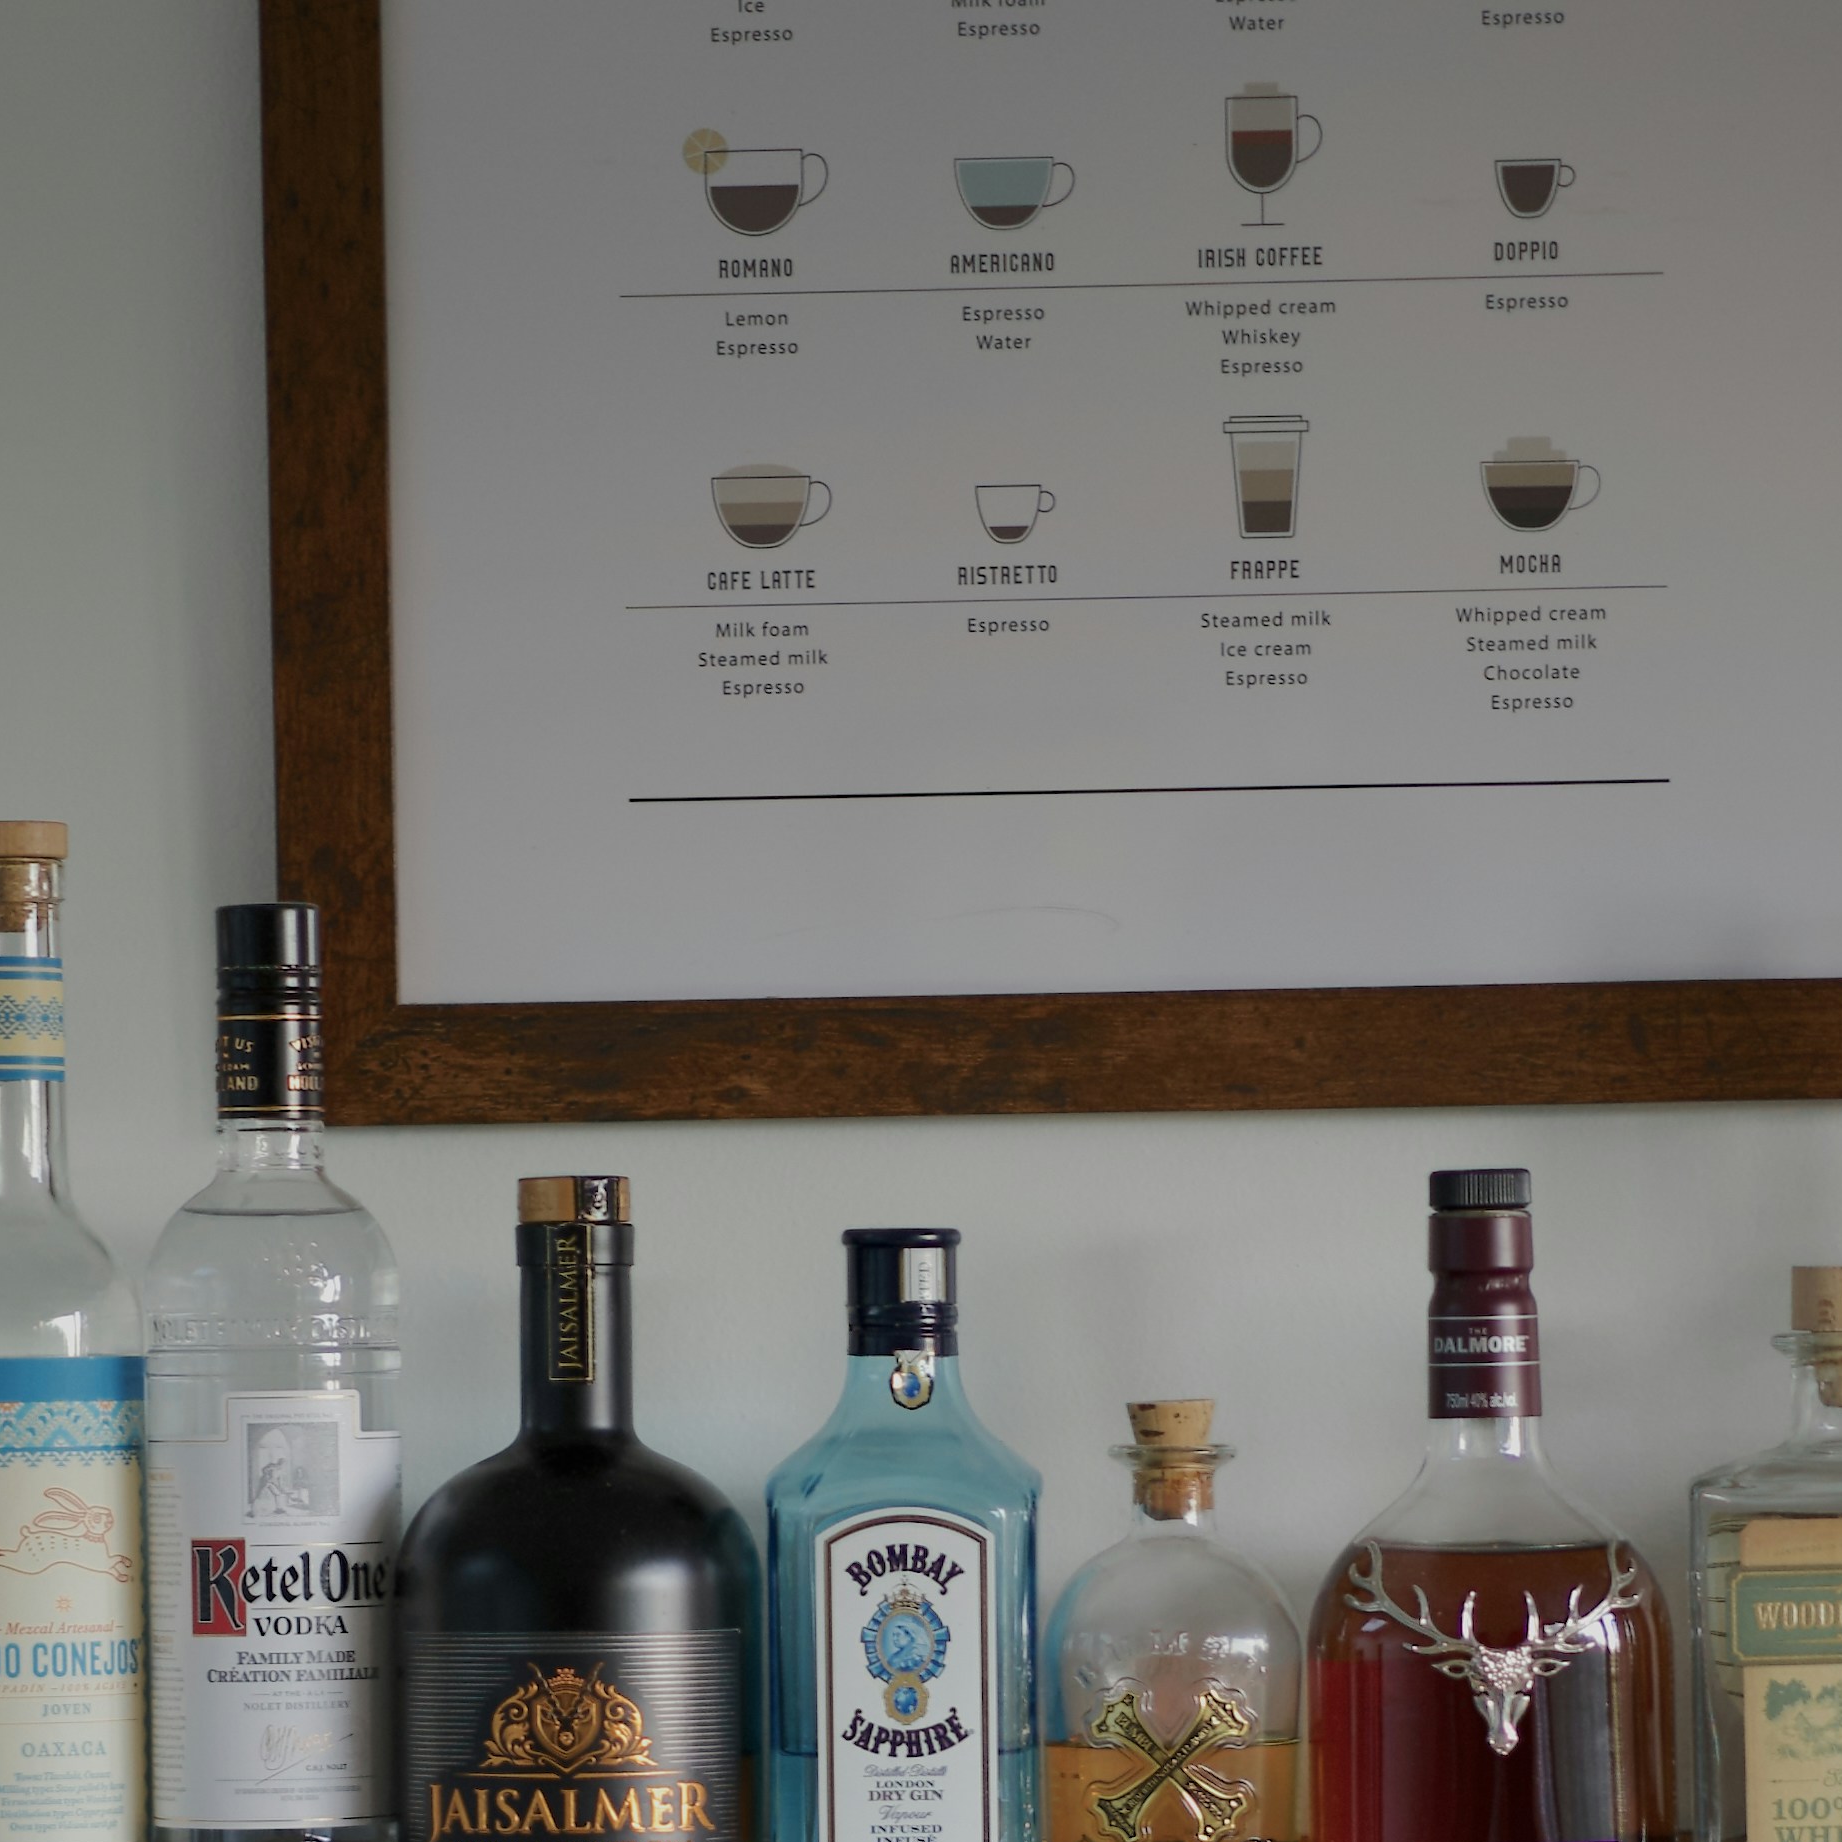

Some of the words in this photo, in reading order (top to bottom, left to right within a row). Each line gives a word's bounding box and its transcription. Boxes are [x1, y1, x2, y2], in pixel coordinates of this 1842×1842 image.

[738, 0, 765, 13] Ice
[1229, 16, 1285, 31] Water
[1481, 10, 1565, 27] Espresso
[710, 27, 794, 45] Espresso
[957, 21, 1041, 39] Espresso
[1197, 248, 1246, 269] IRISH
[1255, 246, 1324, 268] COFFEE
[1494, 241, 1560, 262] DOPPIO
[719, 258, 793, 279] ROMANO
[950, 253, 1055, 274] AMERICANO
[1185, 300, 1272, 319] Whipped
[1278, 301, 1337, 315] cream
[1485, 293, 1570, 312] Espresso
[725, 311, 789, 327] Lemon
[962, 305, 1045, 324] Espresso
[976, 335, 1032, 351] Water
[1222, 328, 1301, 347] Whiskey
[716, 340, 799, 358] Espresso
[1220, 358, 1304, 376] Espresso
[1230, 559, 1300, 580] FRAPPE
[1499, 554, 1562, 574] MOCHA
[707, 571, 751, 592] CAFE
[760, 570, 816, 590] LATTE
[957, 565, 1058, 586] RISTRETTO
[1200, 612, 1284, 629] Steamed
[1291, 610, 1332, 627] milk
[1455, 606, 1541, 626] Whipped
[1549, 608, 1607, 621] cream
[715, 622, 756, 639] Milk
[761, 621, 810, 637] foam
[967, 617, 1050, 635] Espresso
[1220, 642, 1247, 658] Ice
[1254, 642, 1312, 657] cream
[1466, 635, 1550, 652] Steamed
[1557, 634, 1598, 650] milk
[697, 651, 781, 668] Steamed
[788, 649, 829, 665] milk
[1225, 670, 1309, 689] Espresso
[1483, 664, 1581, 682] Chocolate
[722, 680, 805, 698] Espresso
[1490, 694, 1574, 713] Espresso
[556, 1235, 583, 1368] JAISALMER
[1469, 1327, 1488, 1335] THE
[1433, 1335, 1528, 1354] DALMORE
[845, 1544, 965, 1596] BOMBAY
[192, 1543, 315, 1631] Ketel
[320, 1549, 386, 1603] One
[5, 1622, 54, 1636] Mezcal
[56, 1620, 114, 1634] Artesanal
[252, 1615, 349, 1637] VODKA
[32, 1639, 138, 1677] CONEJOS
[236, 1651, 305, 1665] FAMILY
[306, 1650, 356, 1664] MADE
[207, 1666, 291, 1683] CRÉATION
[42, 1703, 92, 1717] JOVEN
[242, 1702, 282, 1711] NOLET
[285, 1700, 351, 1710] DISTILLERY
[842, 1707, 970, 1758] SAPPHIRE
[21, 1741, 107, 1758] OAXACA
[876, 1780, 935, 1789] LONDON
[868, 1790, 906, 1802] DRY
[910, 1789, 944, 1801] GIN
[879, 1804, 933, 1824] Vapour
[871, 1825, 943, 1834] INFUSED
